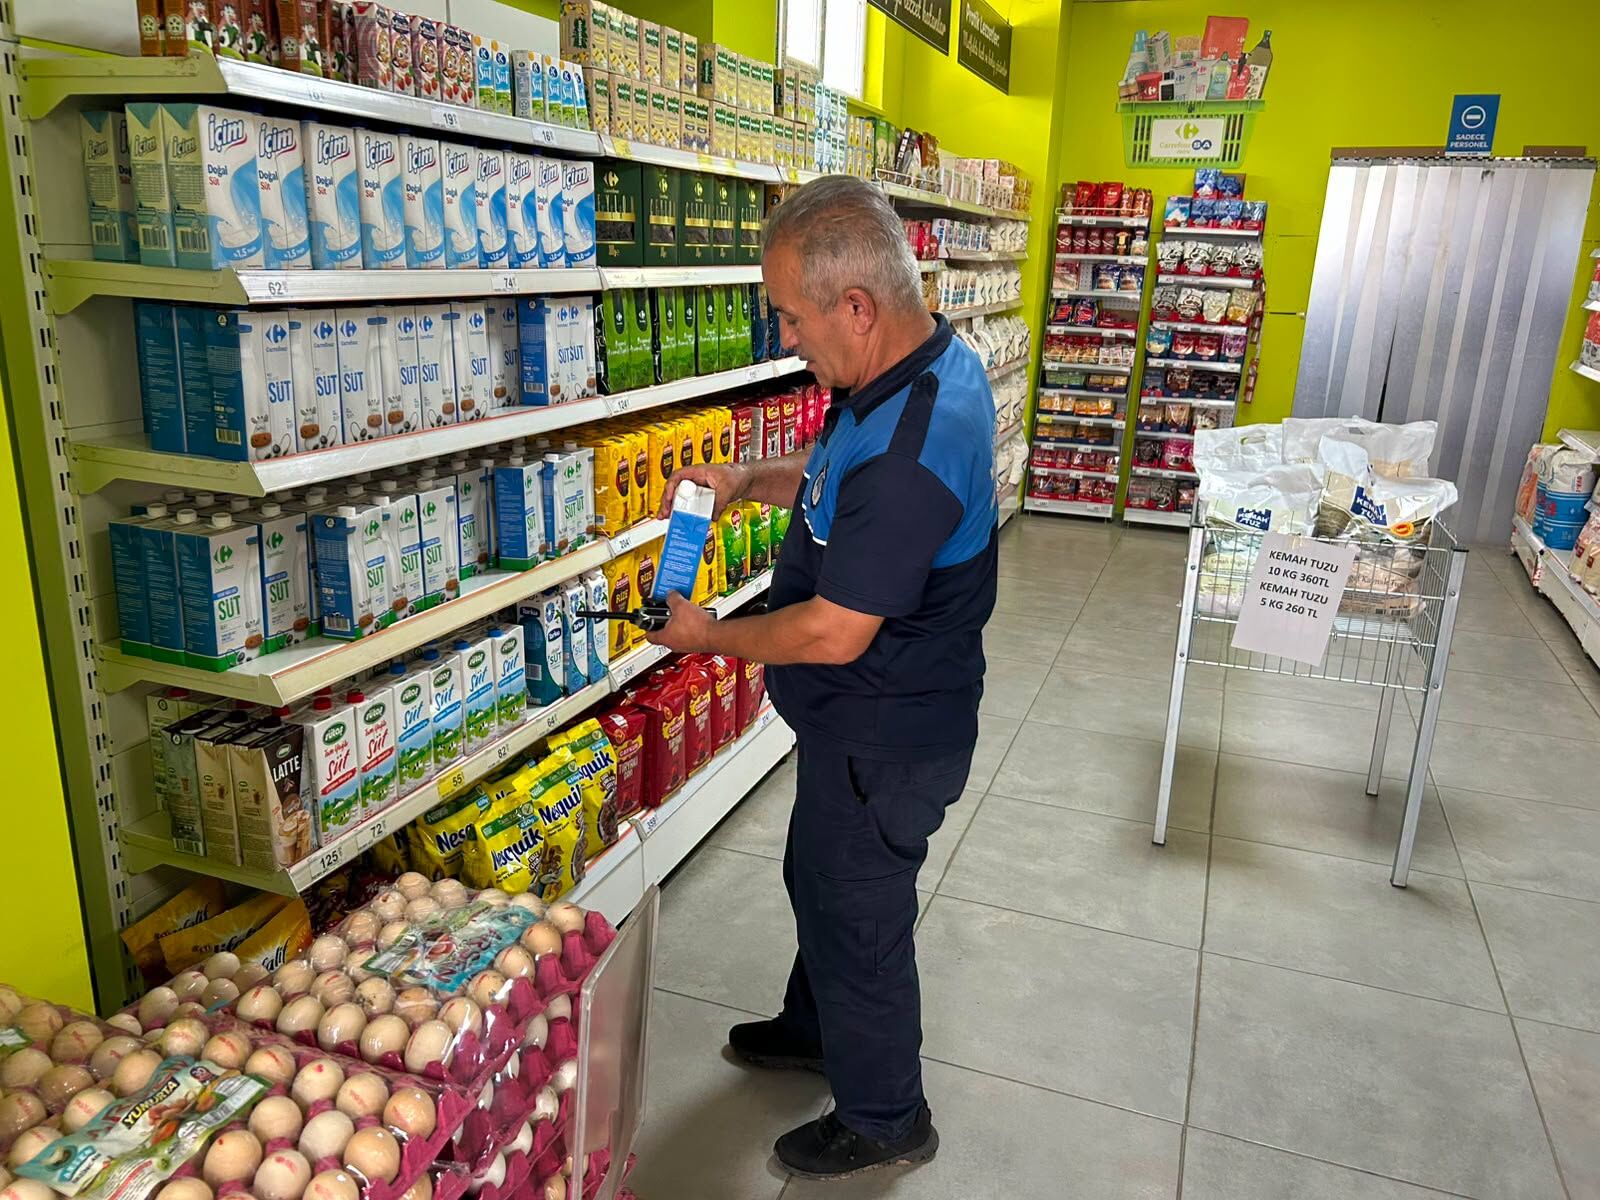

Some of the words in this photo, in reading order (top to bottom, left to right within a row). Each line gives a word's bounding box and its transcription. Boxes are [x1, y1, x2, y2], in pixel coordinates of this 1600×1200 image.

[208, 113, 245, 153] İçim
[259, 122, 293, 159] İçim
[1456, 133, 1486, 141] SADECE
[318, 130, 347, 165] İçim
[365, 136, 392, 170] İçim
[408, 143, 433, 174] İçim
[208, 164, 228, 177] Doğal
[446, 148, 467, 178] İçim
[477, 153, 499, 183] İçim
[510, 157, 530, 186] İçim
[539, 161, 558, 190] İçim
[259, 171, 278, 183] Doğal
[316, 176, 333, 188] Doğal
[562, 165, 588, 191] İçim
[316, 375, 337, 397] SÜT
[344, 372, 363, 393] SÜT
[401, 366, 418, 385] SÜT
[422, 363, 439, 383] SÜT
[268, 381, 291, 403] SÜT
[1269, 551, 1308, 566] KEMAH
[1310, 558, 1339, 573] TUZU
[1268, 566, 1281, 576] 10
[1282, 569, 1298, 580] KG
[1299, 573, 1330, 588] 360TL
[1259, 581, 1298, 597] KEMAH
[1301, 590, 1329, 605] TUZU
[1260, 598, 1268, 606] 5
[1268, 600, 1284, 610] KG
[1285, 603, 1306, 615] 260
[1307, 608, 1319, 619] TL
[502, 652, 519, 677] Süt
[470, 666, 487, 692] Süt
[435, 684, 454, 711] Süt
[403, 701, 423, 729] Süt
[367, 729, 389, 760] Süt
[272, 755, 302, 782] LATTE
[327, 750, 351, 782] Süt
[580, 751, 614, 781] squik
[370, 823, 384, 839] 72
[320, 850, 341, 869] 125
[123, 1081, 178, 1125] YUMURTA
